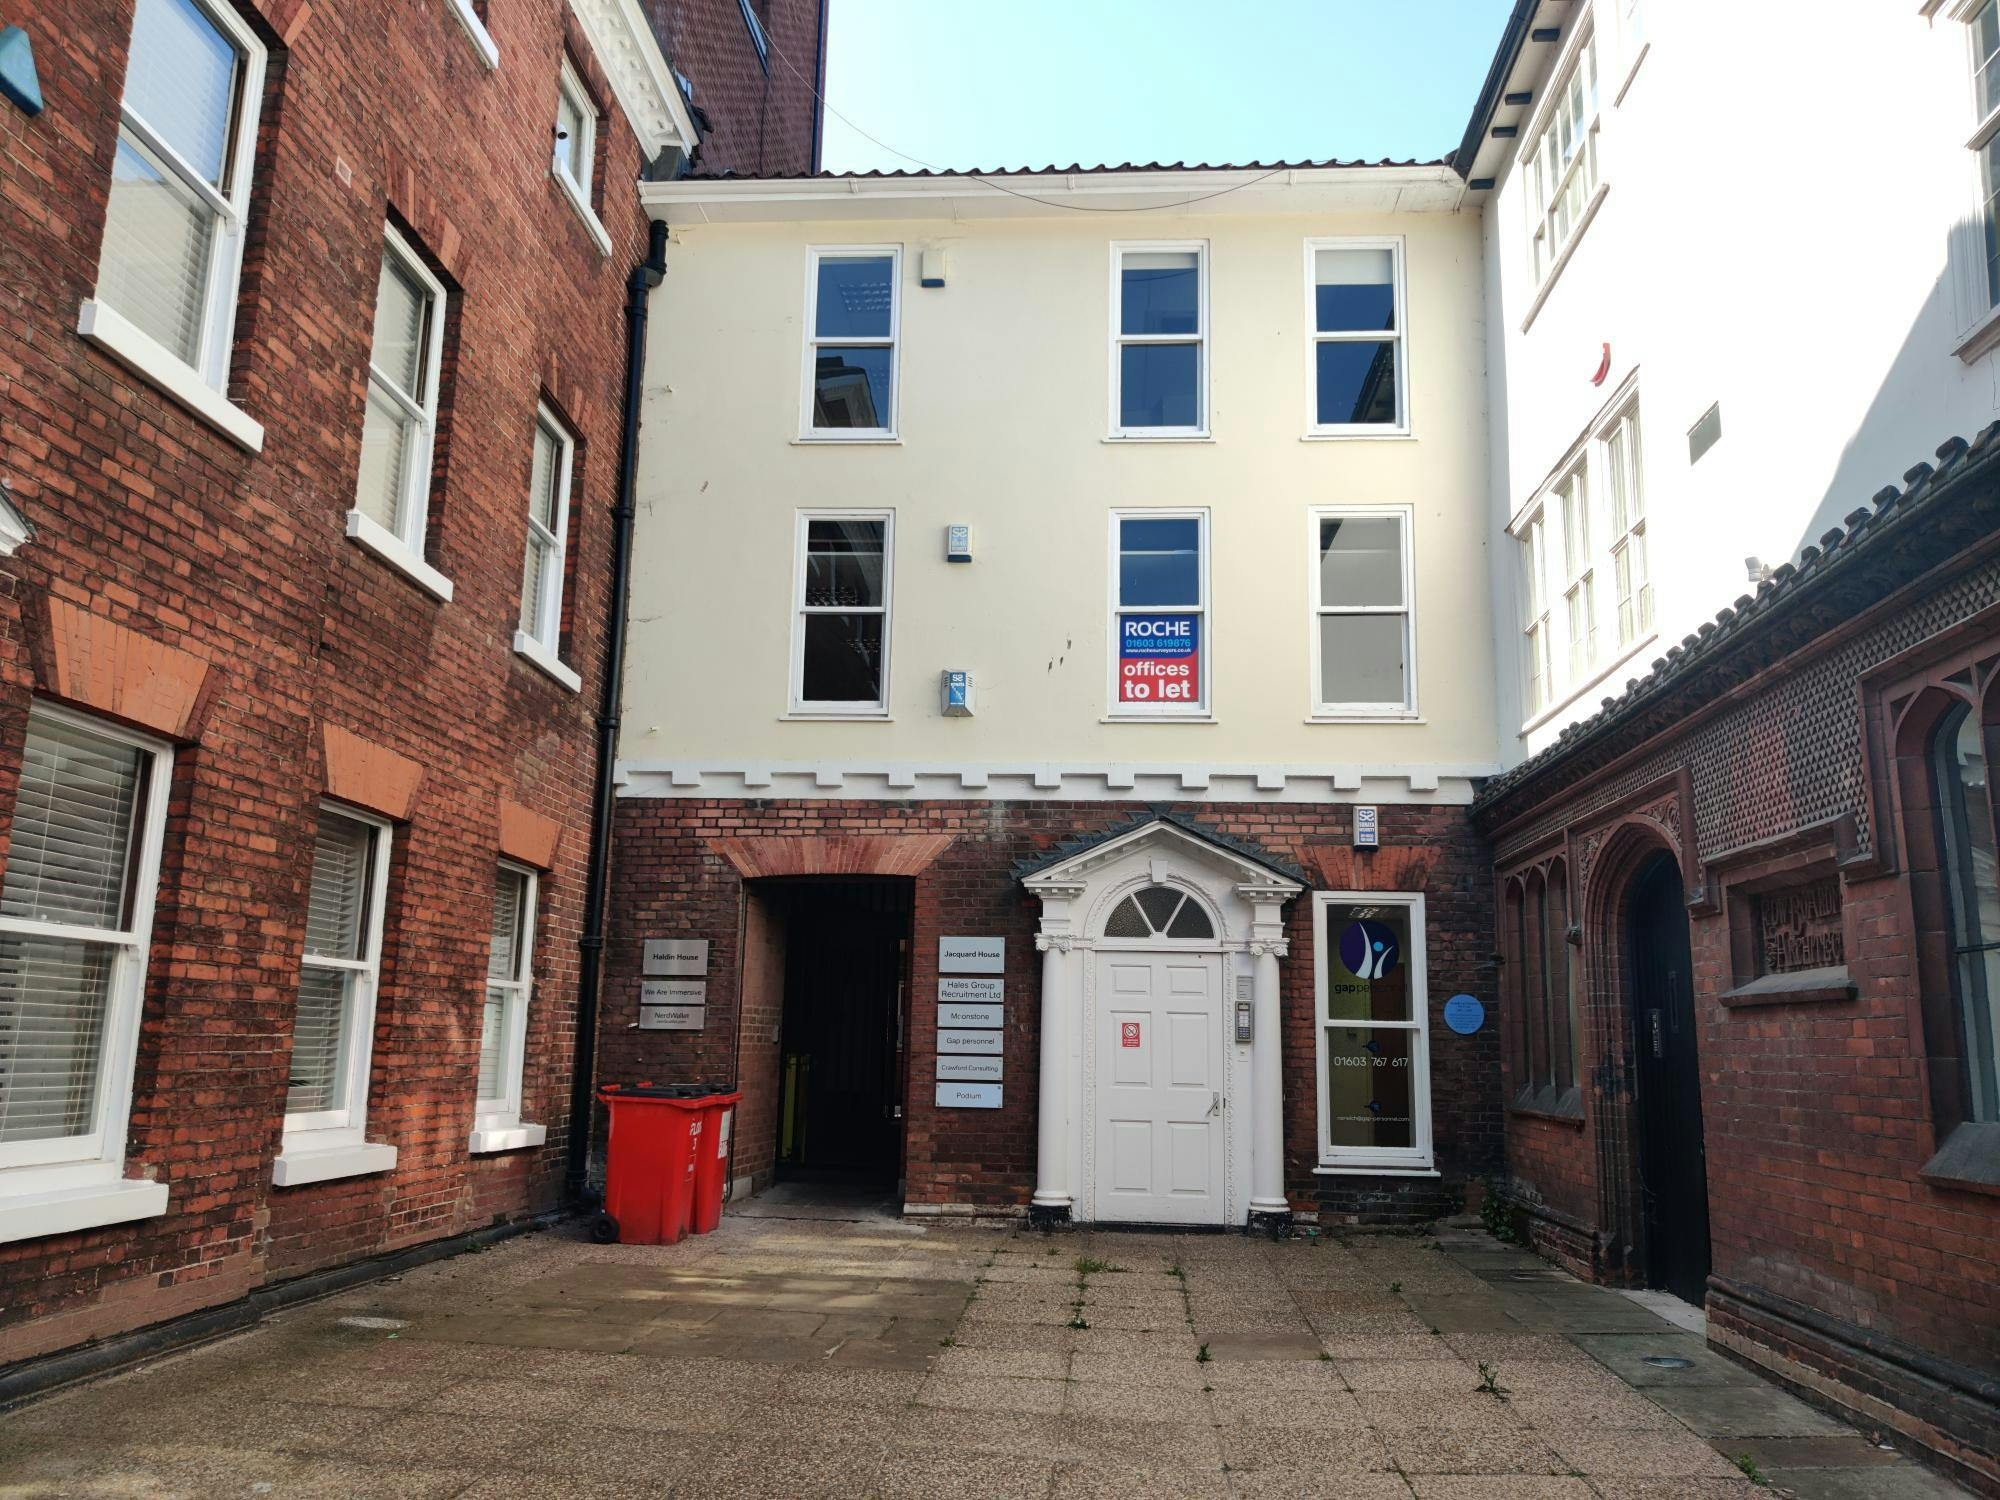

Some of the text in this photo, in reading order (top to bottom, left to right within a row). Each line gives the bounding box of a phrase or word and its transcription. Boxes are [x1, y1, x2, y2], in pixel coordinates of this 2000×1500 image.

[1125, 621, 1190, 636] ROCHE
[1126, 639, 1191, 648] 01603 619876
[1124, 661, 1189, 676] offices
[1124, 680, 1190, 698] to let
[944, 950, 976, 959] Jacquard
[971, 982, 995, 990] Group
[989, 991, 1001, 999] Ltd
[946, 1037, 960, 1045] Gap
[1334, 1056, 1408, 1067] 01603 767 617
